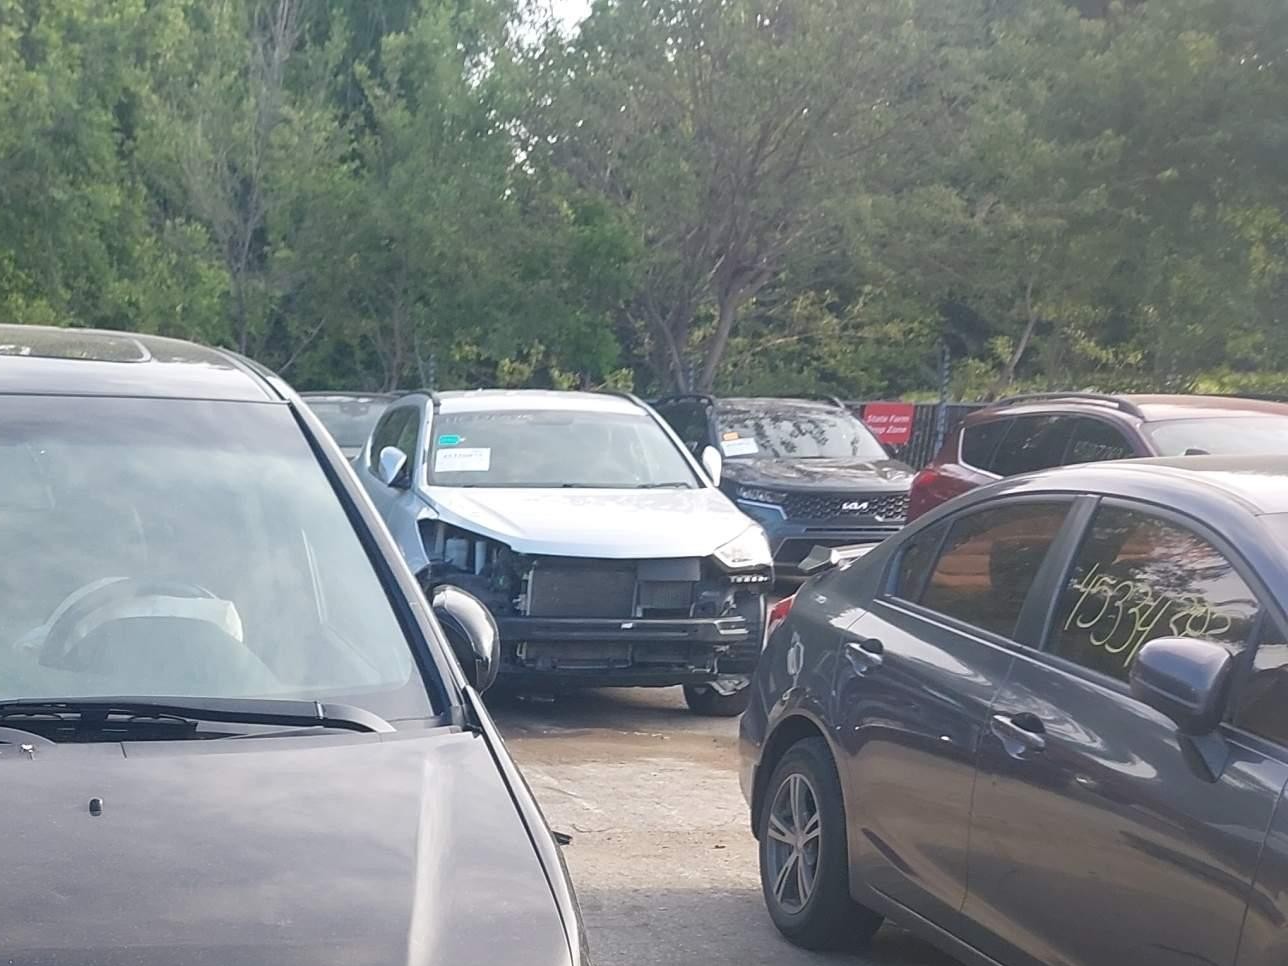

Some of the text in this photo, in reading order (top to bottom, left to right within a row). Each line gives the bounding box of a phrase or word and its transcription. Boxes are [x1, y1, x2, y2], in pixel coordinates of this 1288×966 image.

[866, 415, 911, 423] State Farm
[886, 425, 908, 434] Zone
